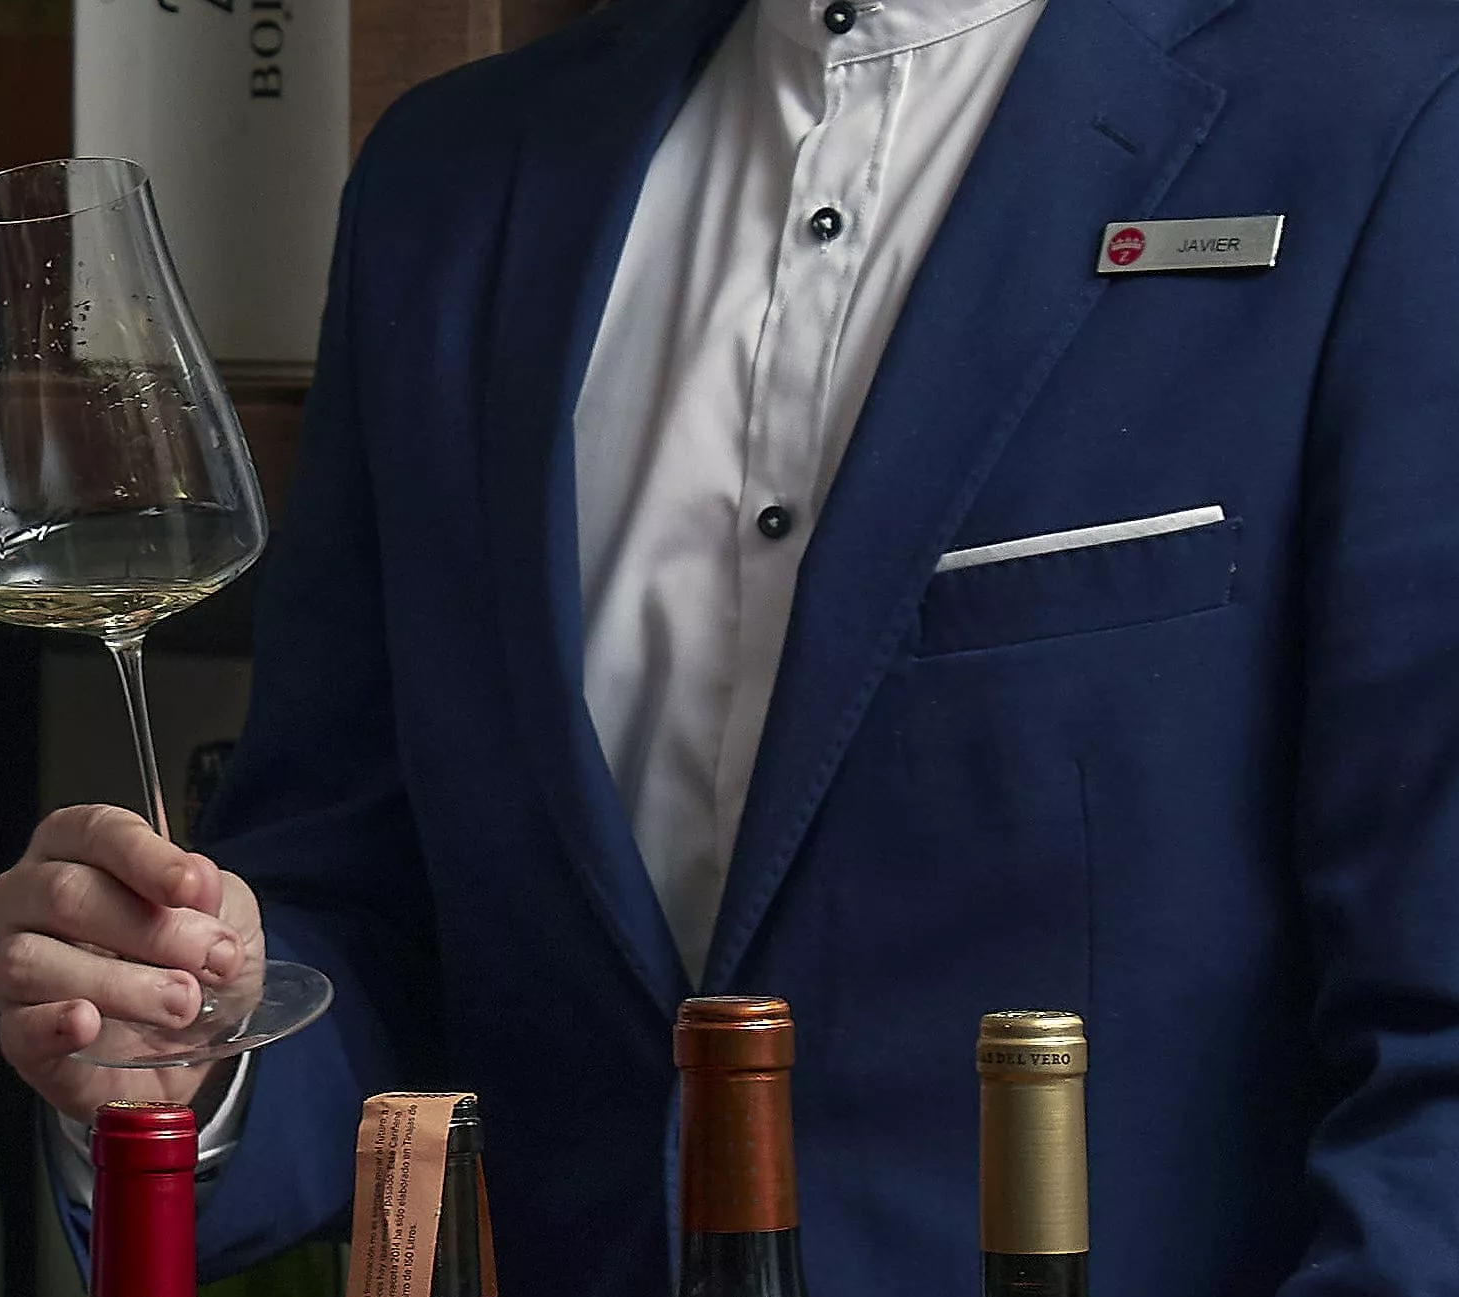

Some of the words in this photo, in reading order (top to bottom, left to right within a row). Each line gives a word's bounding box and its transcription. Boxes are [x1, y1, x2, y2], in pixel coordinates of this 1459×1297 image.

[1177, 236, 1241, 253] JAVIER
[1030, 1053, 1071, 1066] VERO
[404, 1251, 415, 1267] 150
